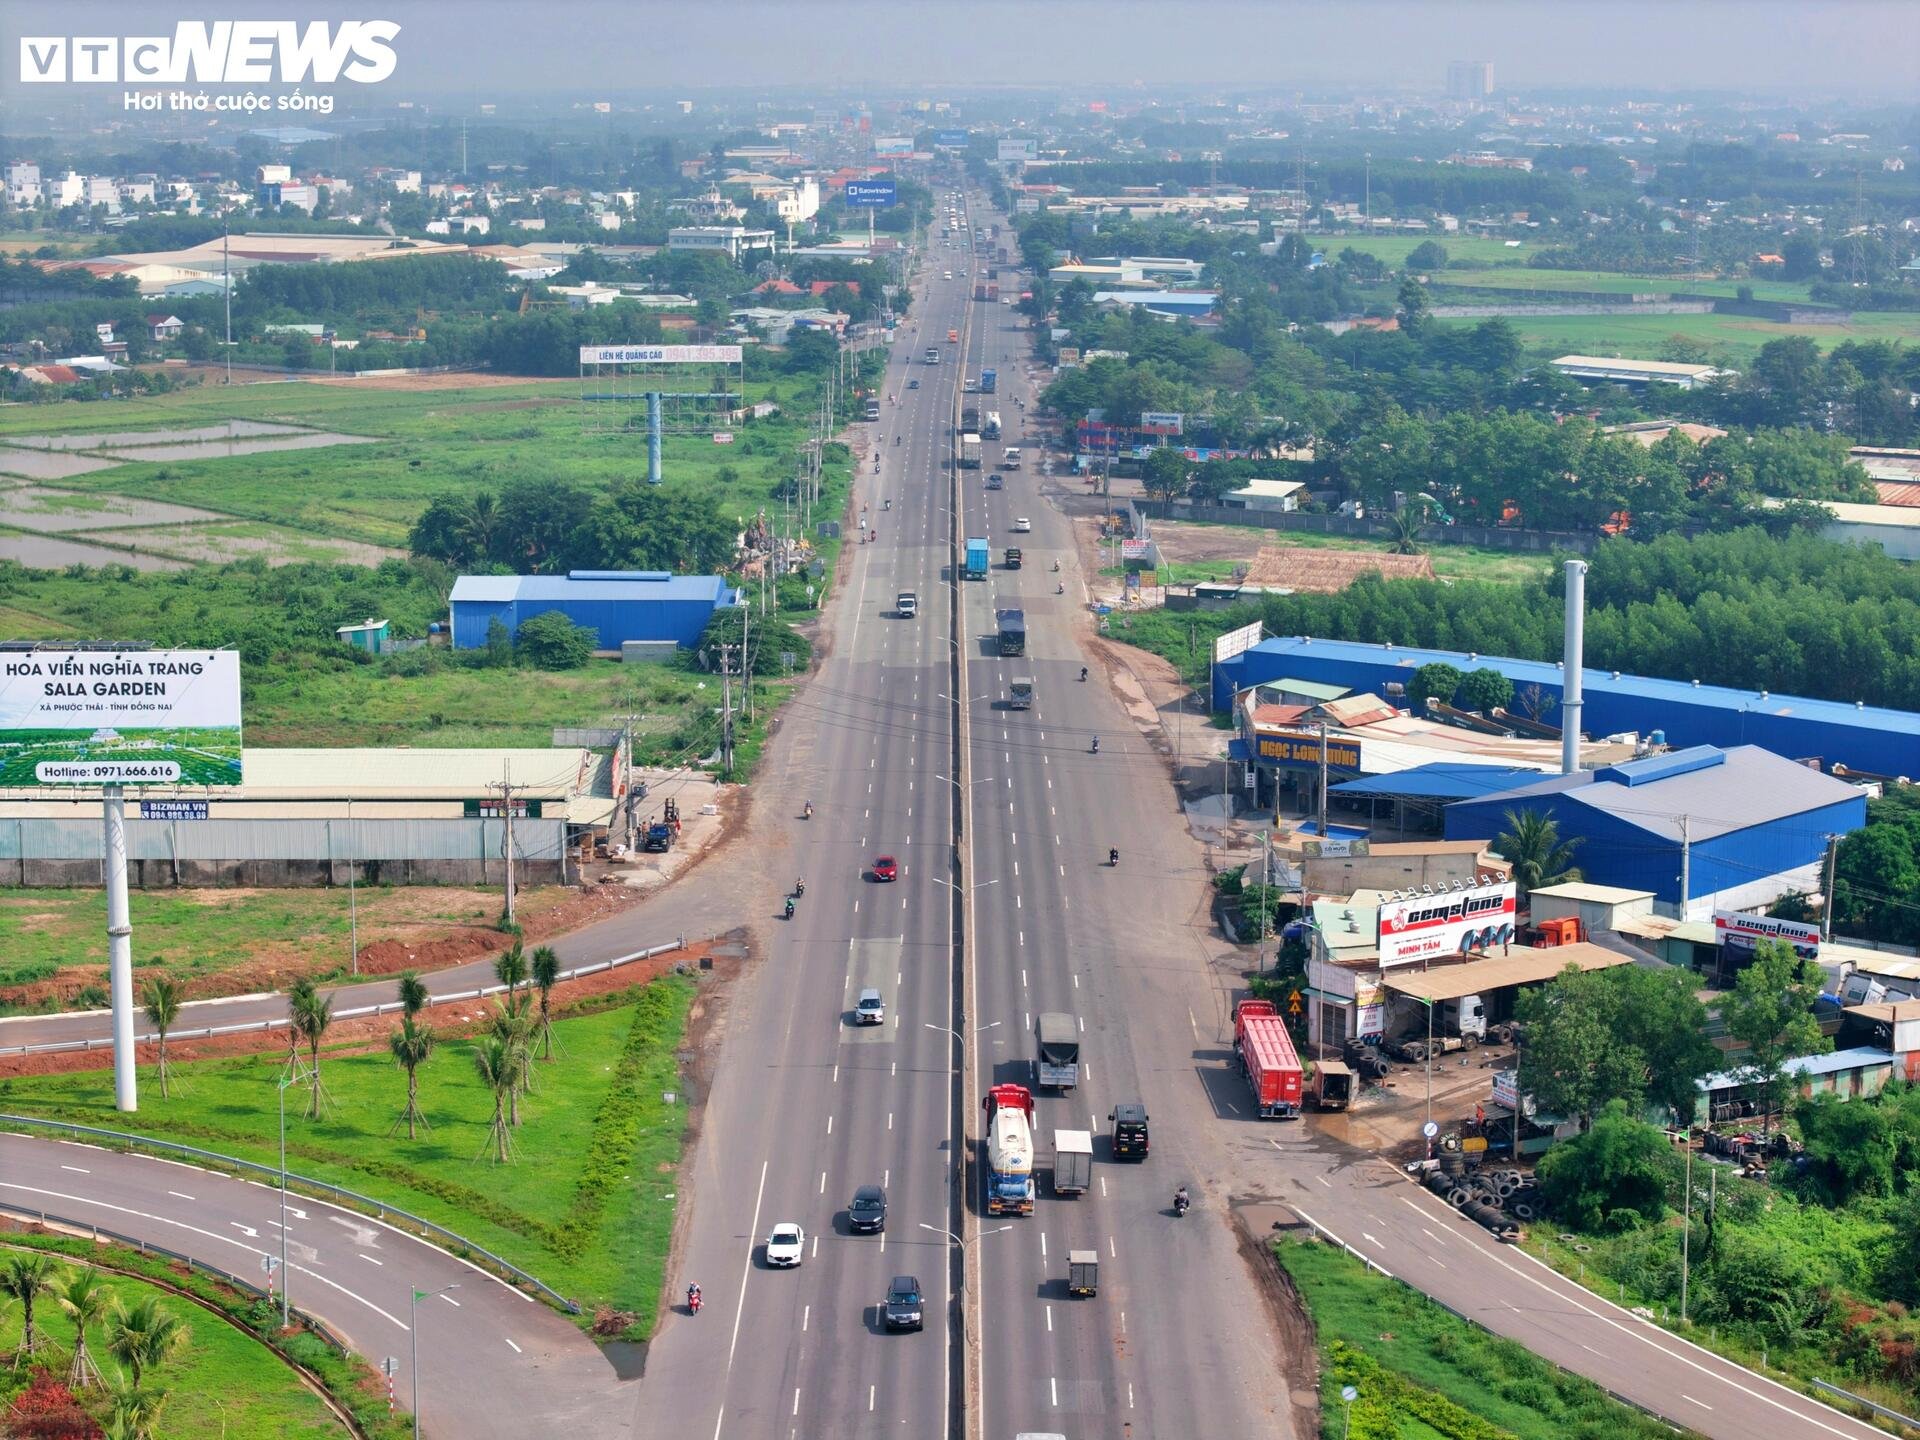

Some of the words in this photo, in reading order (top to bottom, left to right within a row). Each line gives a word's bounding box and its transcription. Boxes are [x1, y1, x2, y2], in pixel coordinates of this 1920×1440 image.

[6, 663, 43, 676] HOA
[48, 660, 84, 676] VIÊN
[90, 660, 143, 676] NGHĨA
[148, 662, 204, 675] TRANG
[44, 682, 88, 696] SALA
[93, 682, 166, 696] GARDEN
[85, 702, 103, 711] THÁI
[158, 703, 173, 711] NAI
[44, 766, 91, 778] Hotline:
[93, 766, 173, 777] 0971.666.616
[150, 803, 207, 811] BIZMAN.VN
[1398, 944, 1421, 956] MINH
